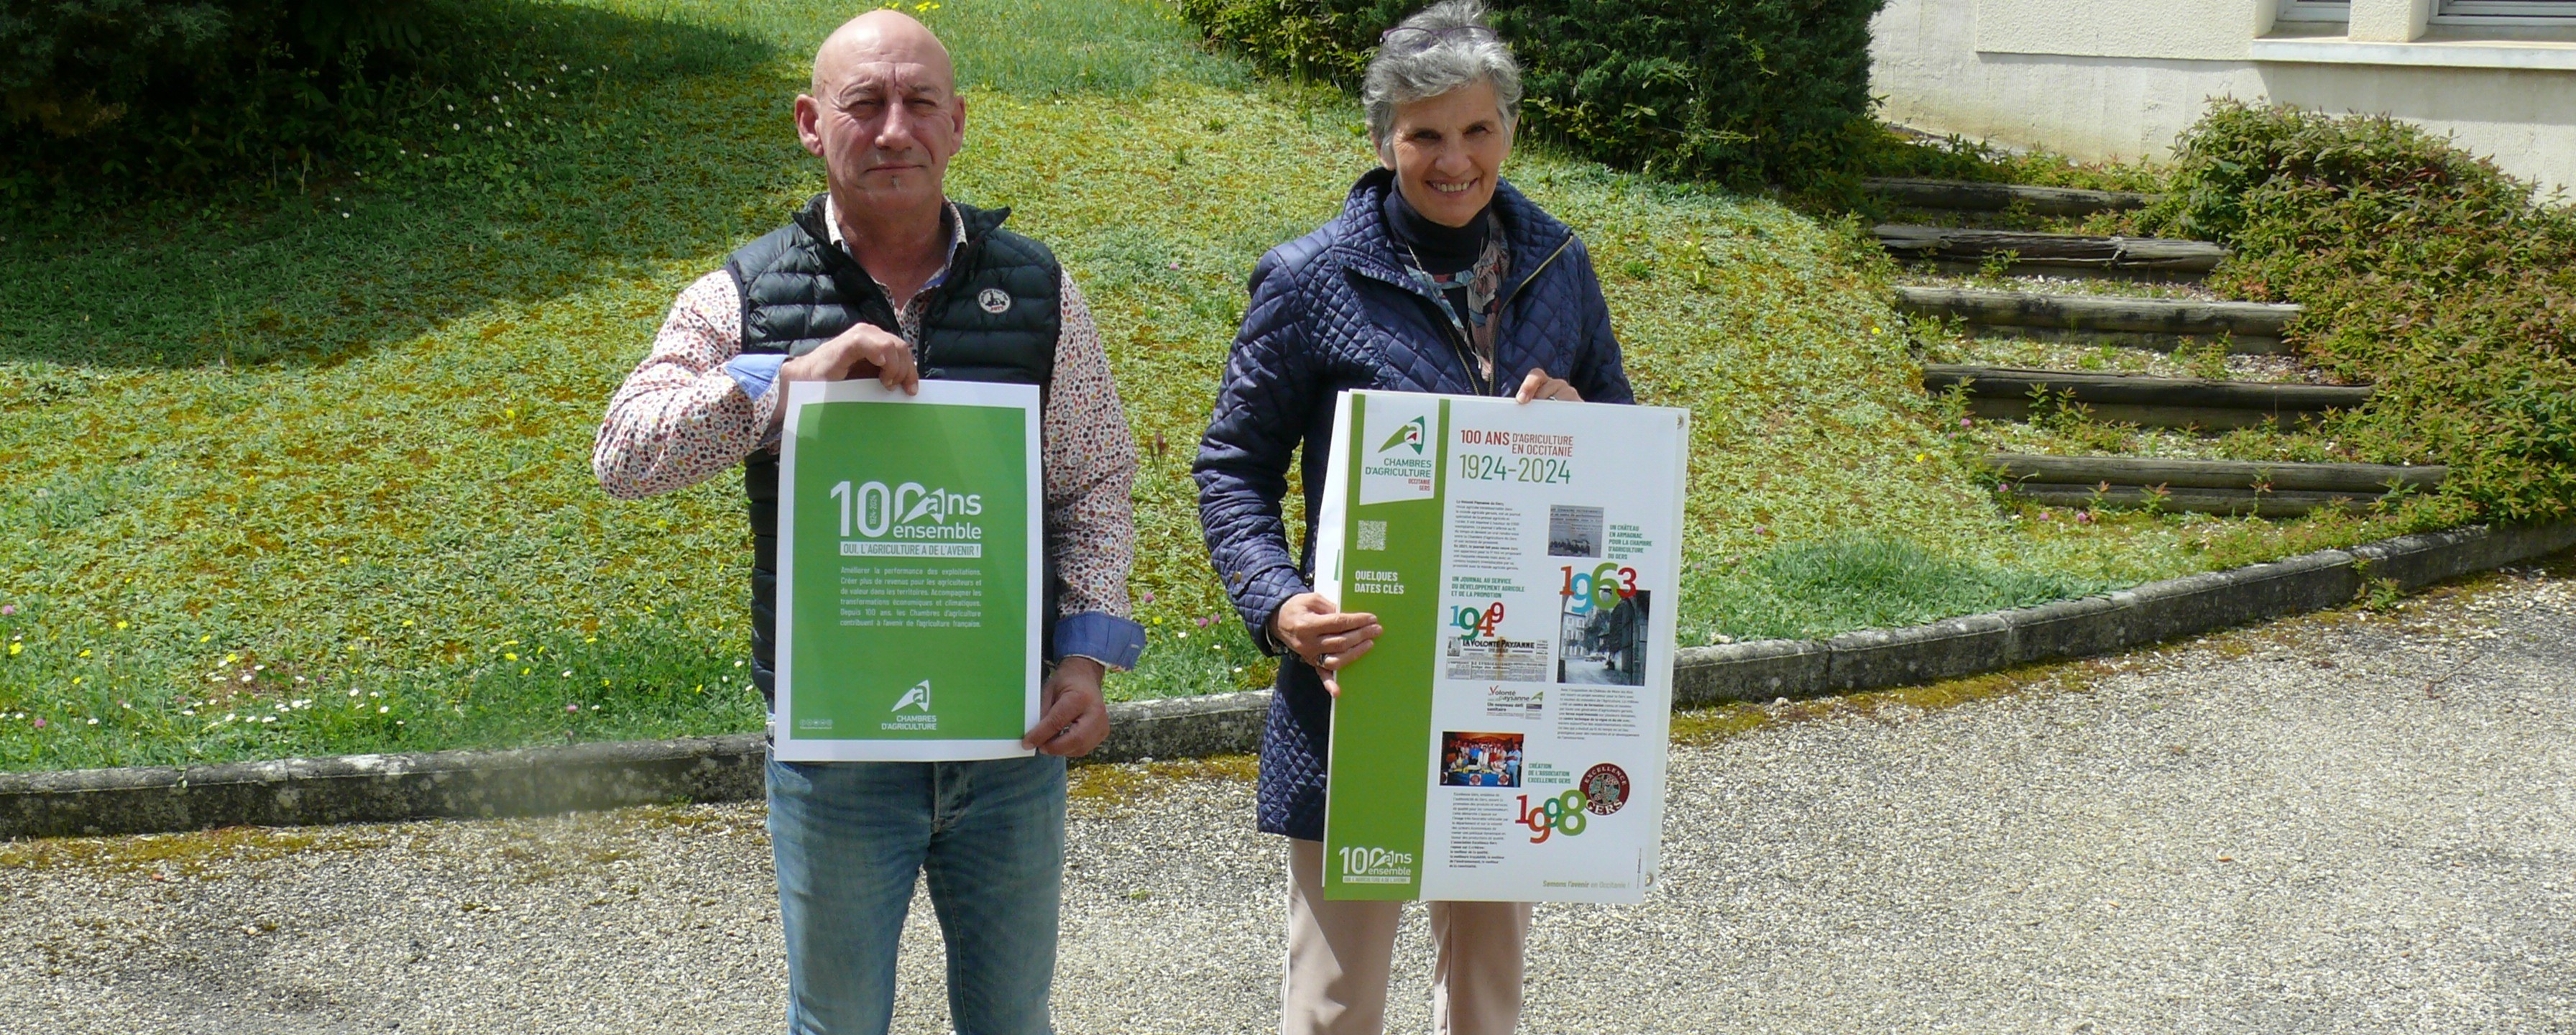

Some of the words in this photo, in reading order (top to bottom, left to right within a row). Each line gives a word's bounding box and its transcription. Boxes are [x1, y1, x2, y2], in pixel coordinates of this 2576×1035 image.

[1460, 430, 1481, 444] 100
[1485, 431, 1509, 446] ANS
[1512, 433, 1573, 446] D'AGRICULTURE
[1512, 443, 1524, 454] EN
[1527, 444, 1573, 457] OCCITANIE
[1384, 458, 1432, 468] CHAMBRES
[1459, 454, 1570, 484] 1924-2024
[1365, 466, 1431, 478] D'AGRICULTURE
[924, 491, 982, 518] ans
[893, 522, 981, 539] ensemble
[860, 543, 919, 555] L'AGRICULTURE
[921, 545, 926, 554] A
[929, 545, 939, 554] DE
[941, 546, 974, 555] L'AVENIR
[1355, 570, 1398, 581] QUELQUES
[1354, 583, 1381, 594] DATES
[1383, 583, 1404, 594] CLÉS
[1559, 562, 1637, 614] 1963
[1449, 602, 1504, 640] 1949
[1501, 640, 1535, 648] PAYSANNE
[1489, 685, 1516, 696] Volonté
[1584, 766, 1627, 786] EXCELLENCE
[1586, 799, 1623, 815] GERS
[1515, 789, 1587, 844] 1998
[1383, 852, 1412, 865] ans
